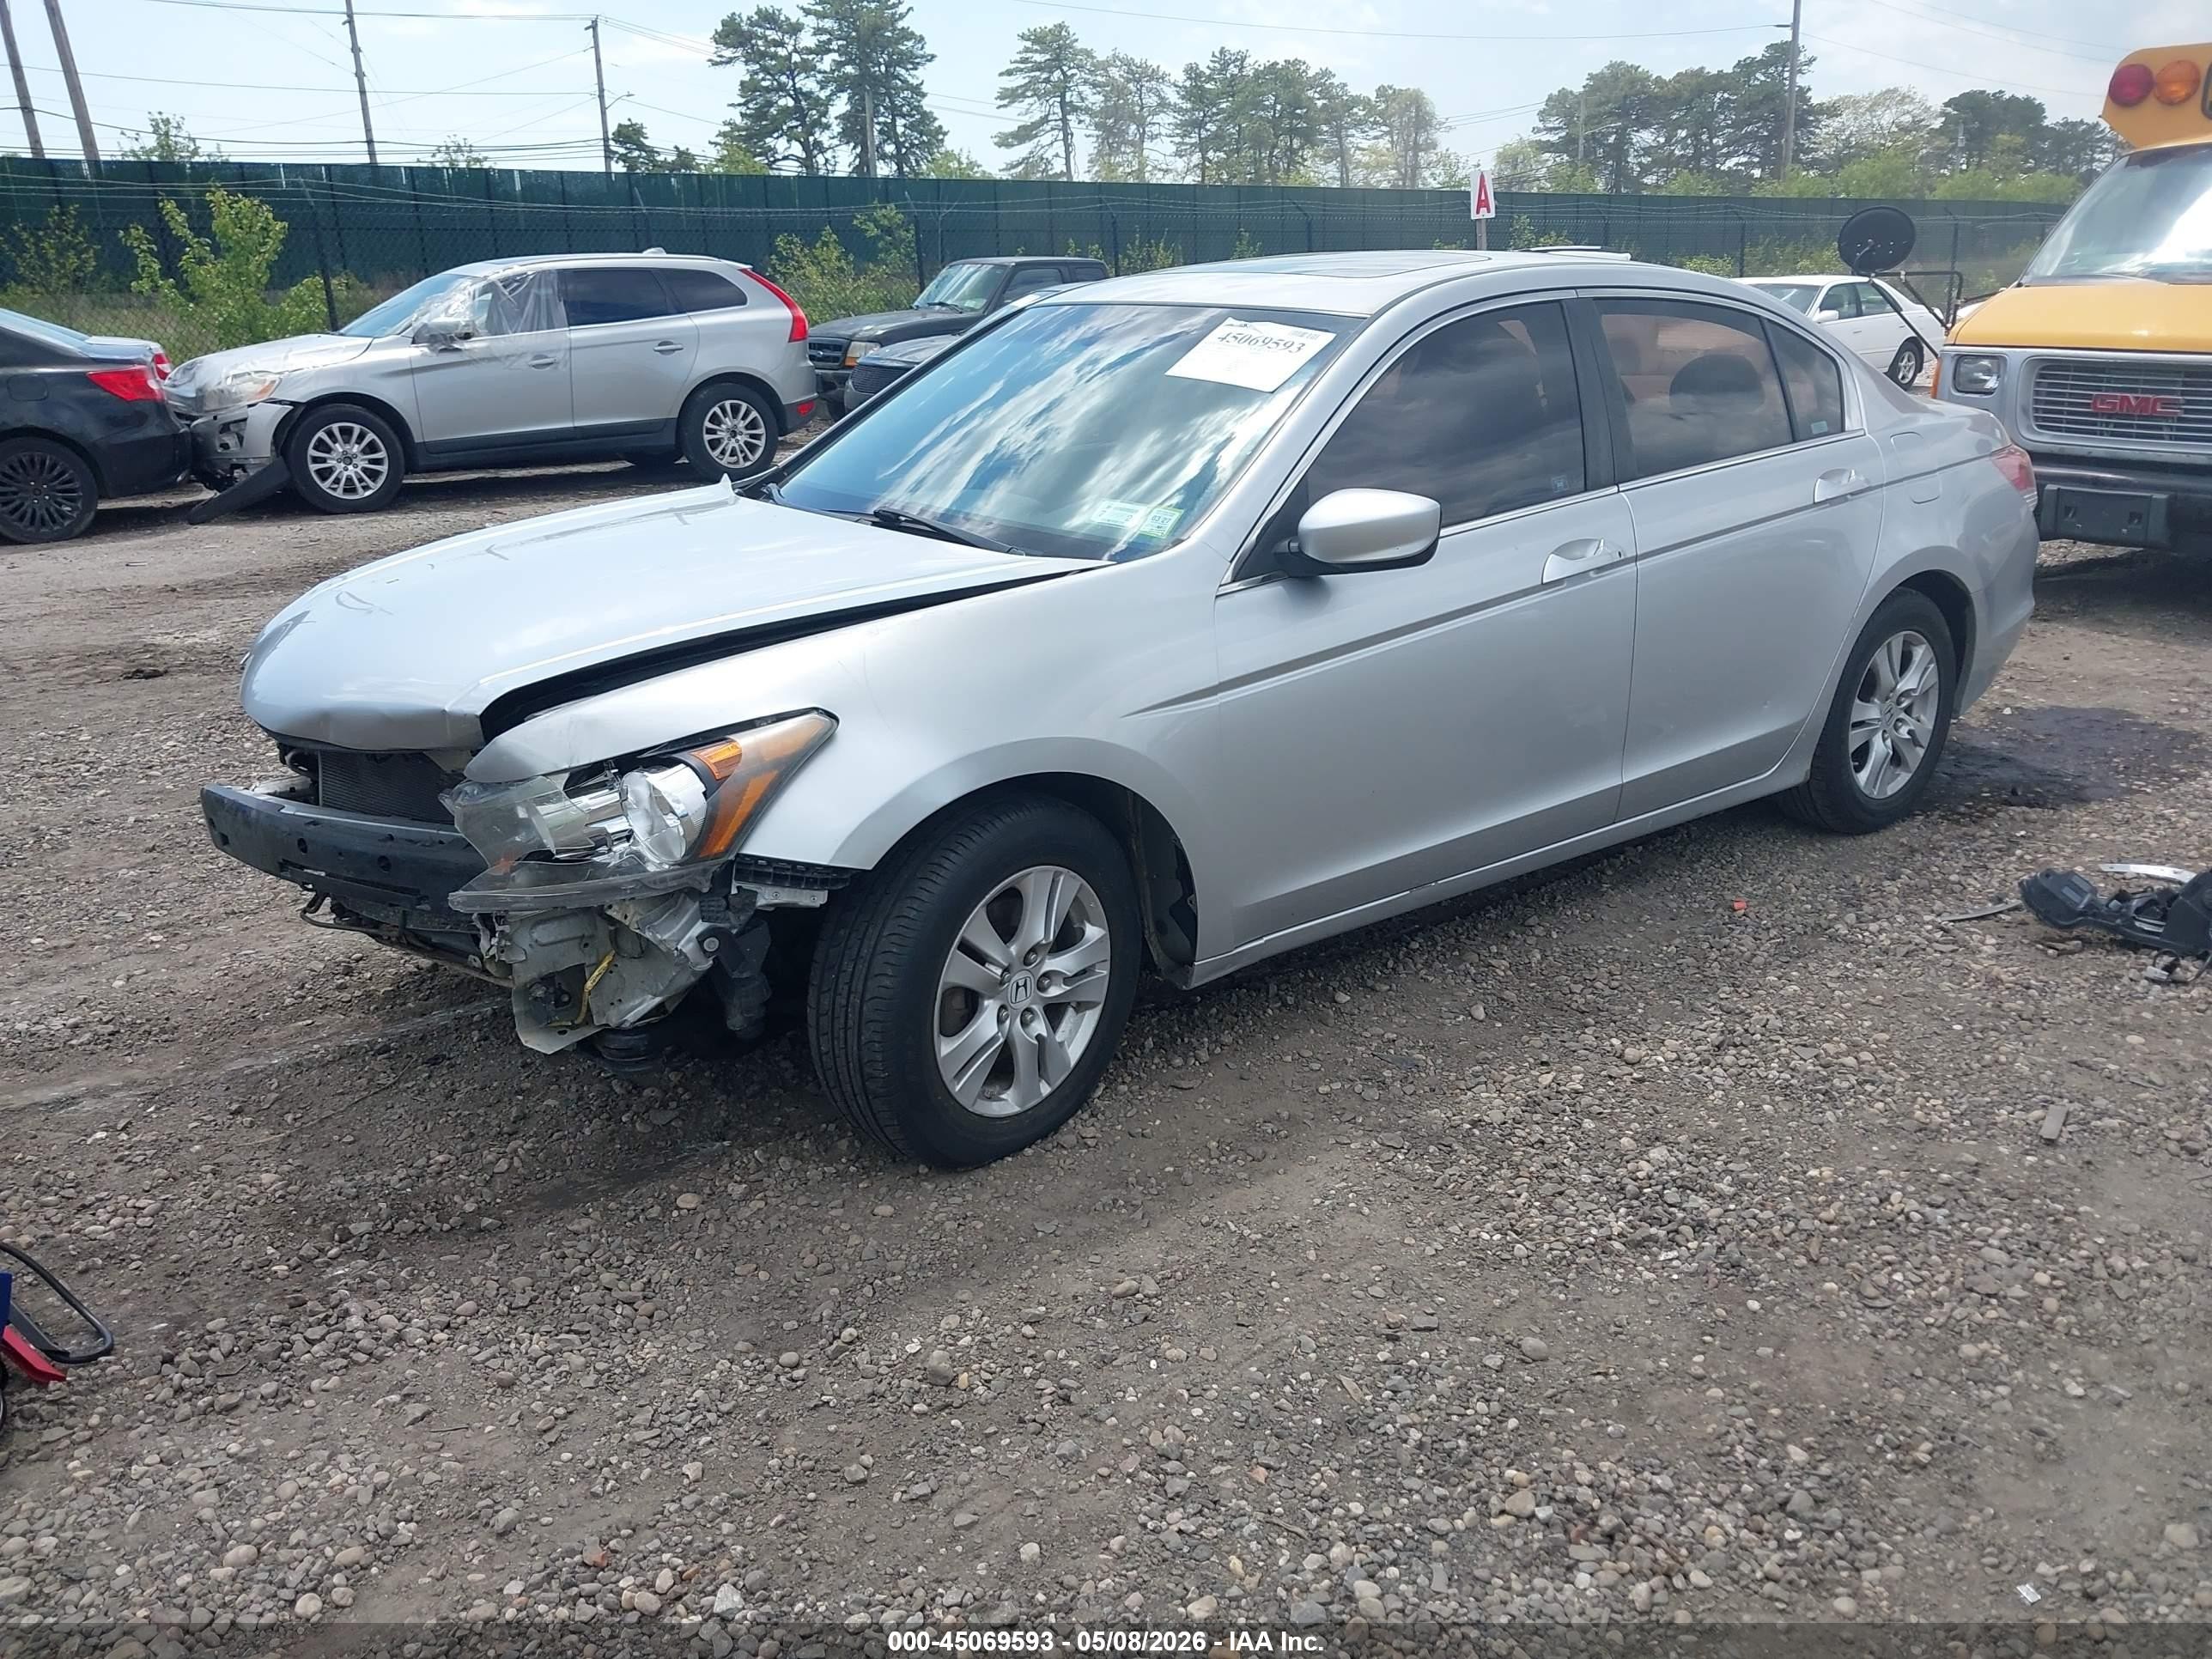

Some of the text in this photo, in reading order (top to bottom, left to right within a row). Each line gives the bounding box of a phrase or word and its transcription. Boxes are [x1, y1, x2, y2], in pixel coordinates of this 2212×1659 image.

[1475, 171, 1492, 215] A
[1217, 331, 1306, 354] 45069593
[2090, 392, 2185, 417] GMC
